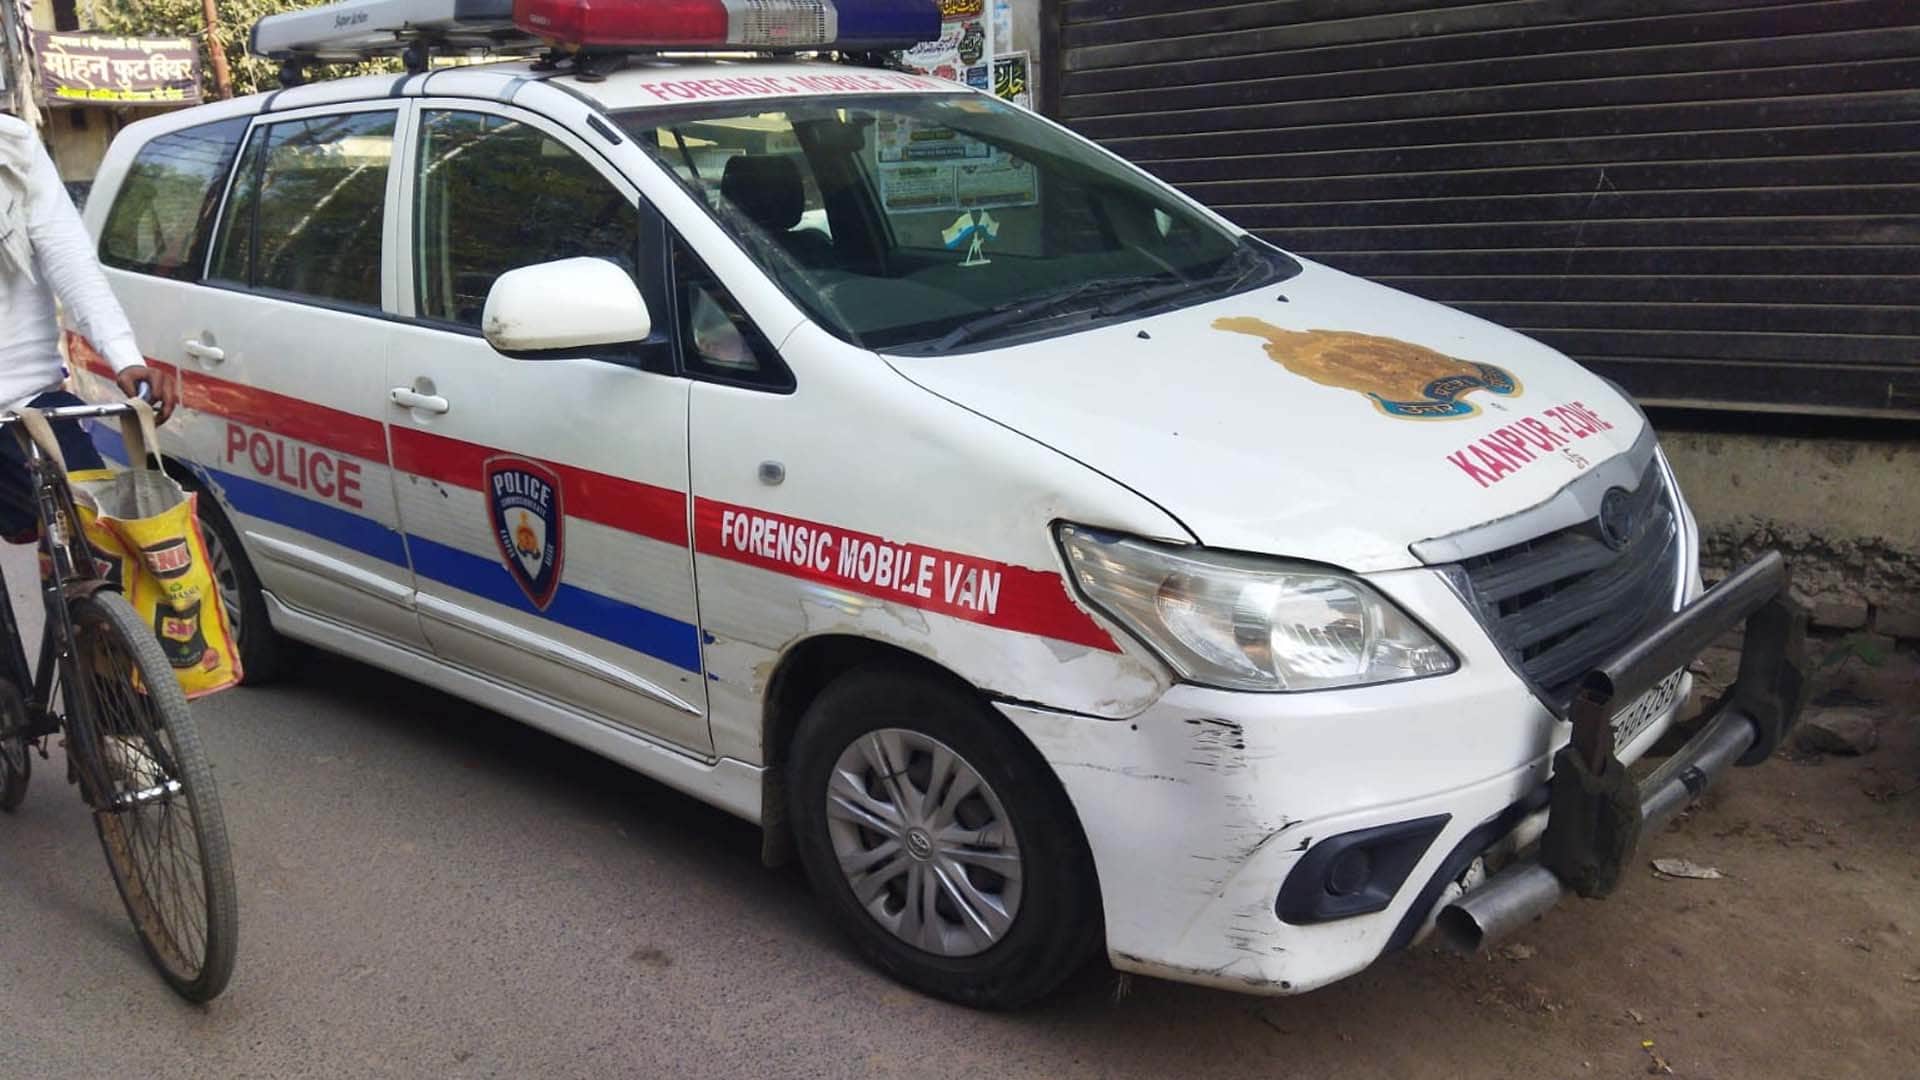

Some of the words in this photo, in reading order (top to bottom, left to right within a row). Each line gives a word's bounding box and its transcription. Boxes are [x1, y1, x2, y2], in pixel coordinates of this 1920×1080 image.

[41, 43, 109, 89] मोहन
[111, 59, 148, 91] फुट
[641, 76, 796, 101] FORENSIC
[789, 75, 893, 93] MOBILE
[226, 423, 363, 509] POLICE
[493, 471, 551, 507] POLICE
[721, 510, 832, 573] FORENSIC
[837, 536, 934, 598] MOBILE
[943, 560, 1001, 615] VAN
